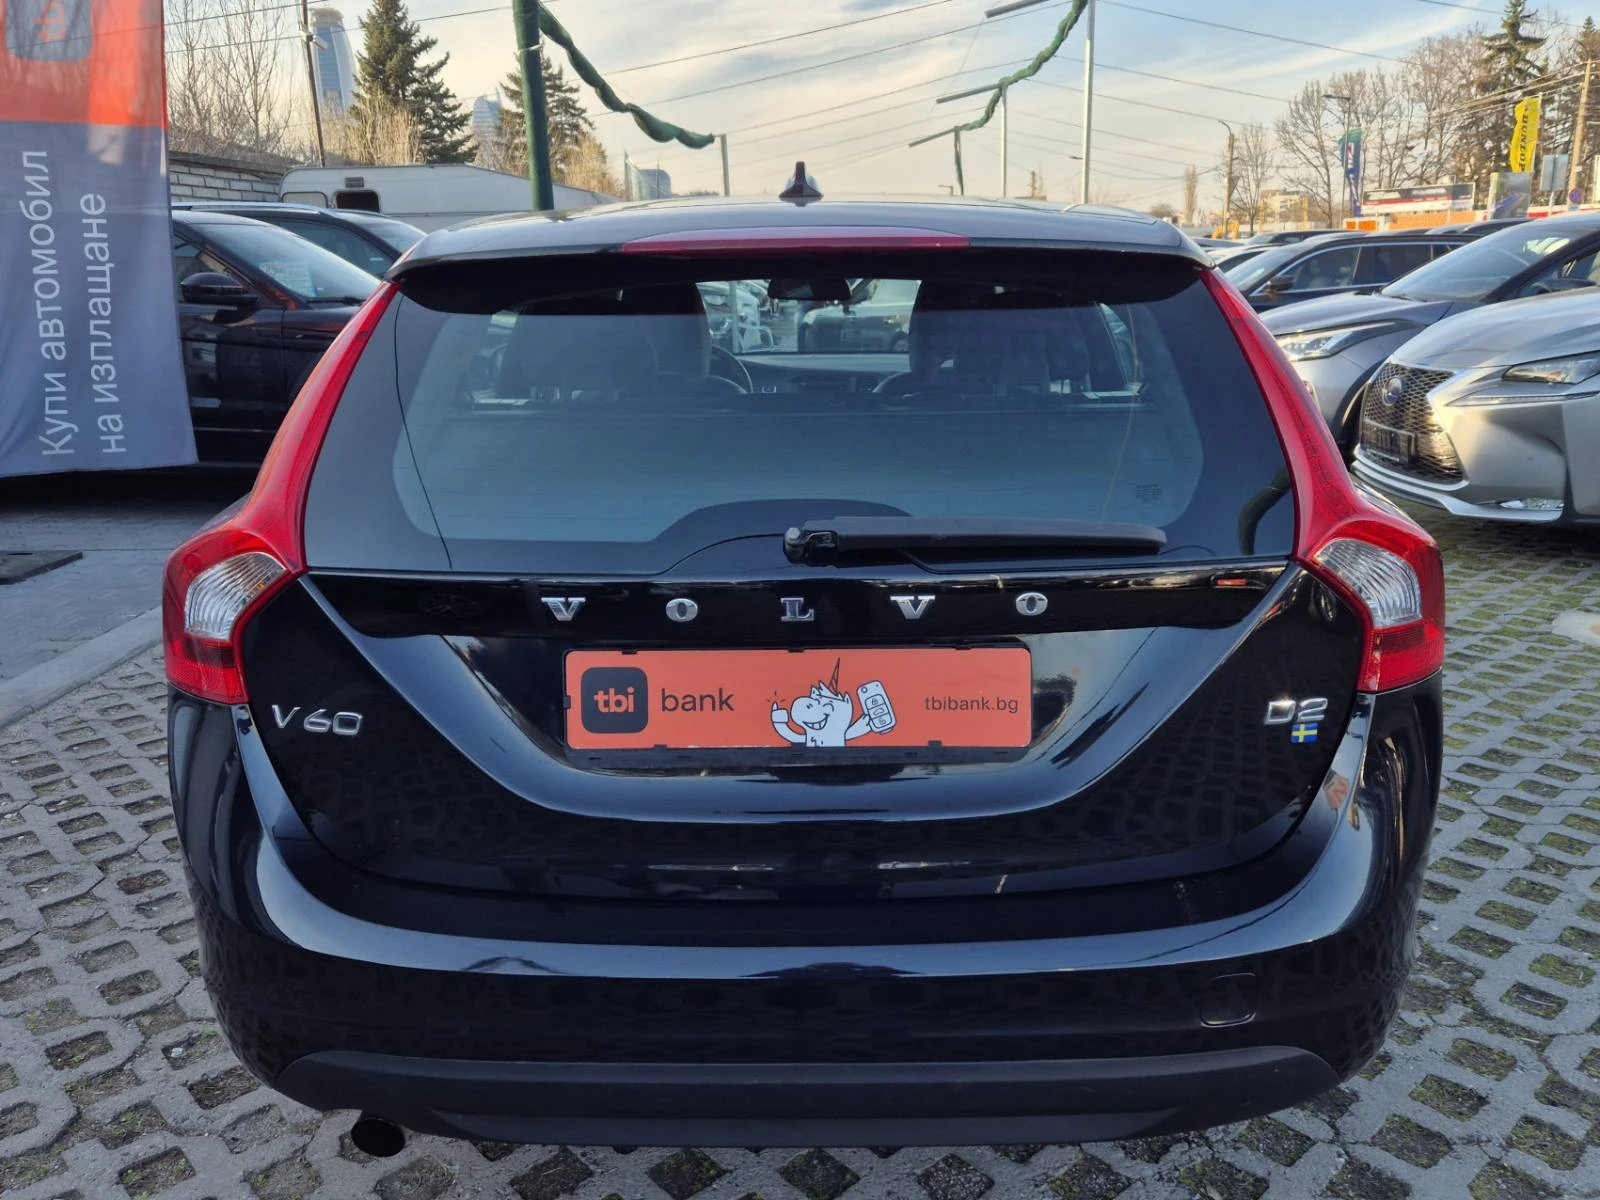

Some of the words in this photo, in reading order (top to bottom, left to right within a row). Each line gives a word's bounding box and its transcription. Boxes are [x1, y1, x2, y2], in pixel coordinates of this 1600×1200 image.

[33, 0, 66, 44] tb
[1518, 114, 1529, 172] DUNLOP
[19, 150, 67, 360] автомобил
[79, 193, 121, 404] изплащане
[38, 371, 79, 457] Купи
[98, 412, 127, 453] на
[541, 592, 1049, 622] VOLVO
[272, 704, 364, 736] V60
[593, 688, 635, 714] tbi
[660, 688, 735, 712] bank
[924, 695, 1019, 714] tbibank.bg
[1263, 697, 1329, 725] D2
